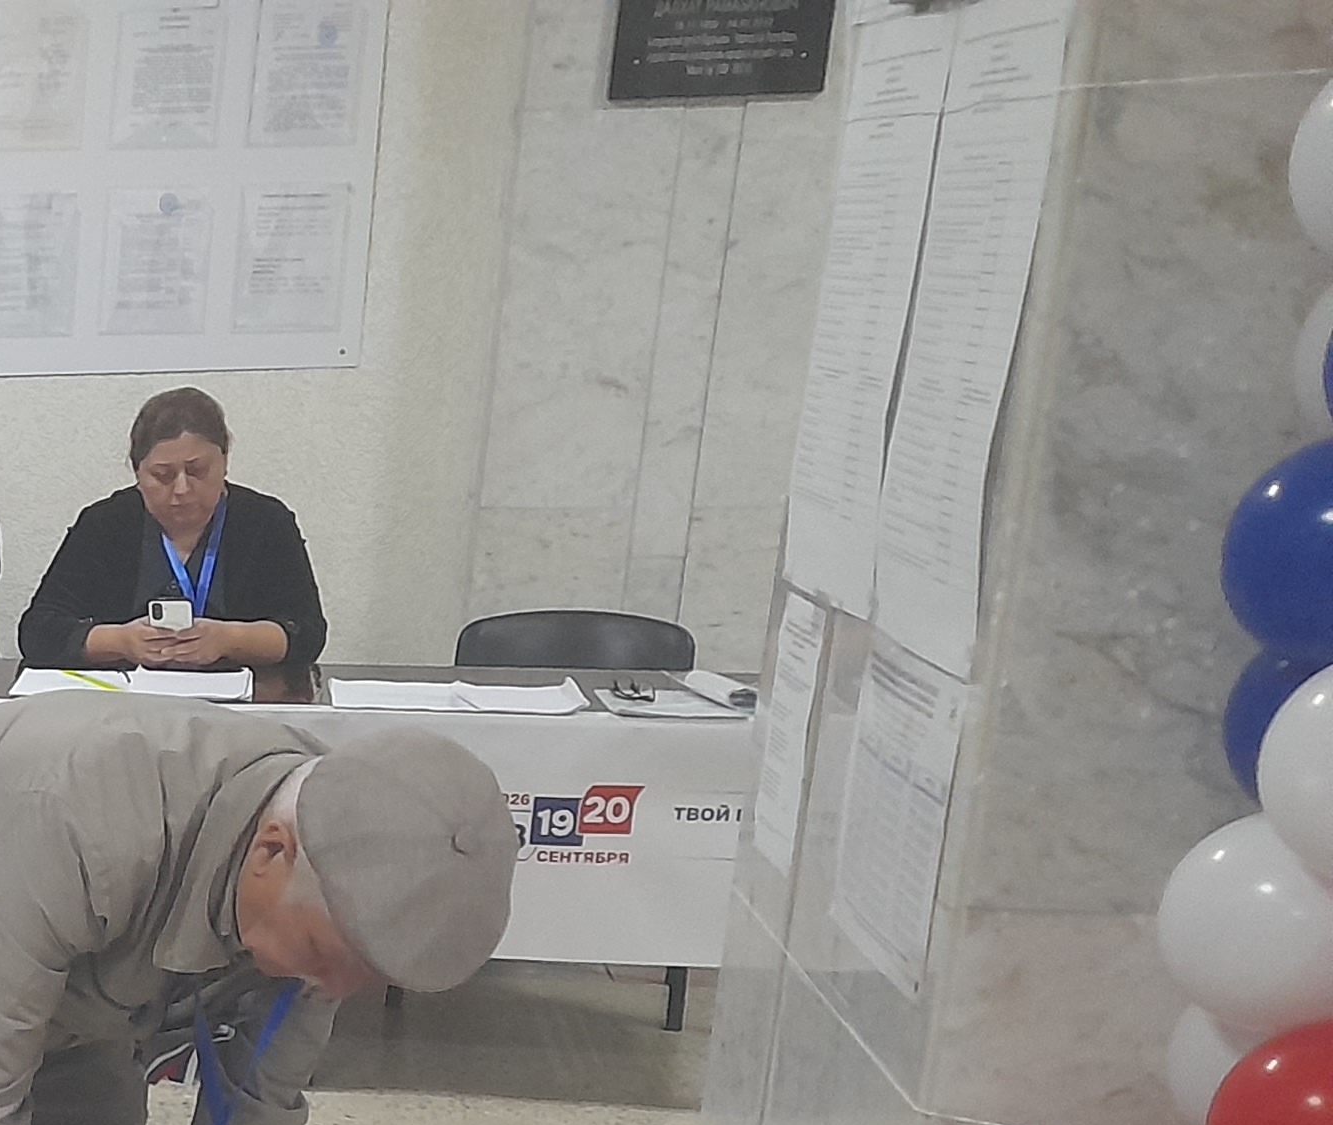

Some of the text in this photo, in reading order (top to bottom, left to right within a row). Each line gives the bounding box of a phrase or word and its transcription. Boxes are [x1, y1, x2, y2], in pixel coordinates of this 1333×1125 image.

[536, 809, 575, 836] 19
[583, 796, 630, 824] 20
[674, 804, 730, 822] ТВОЙ
[536, 850, 629, 864] СЕНТЯБРЯ
